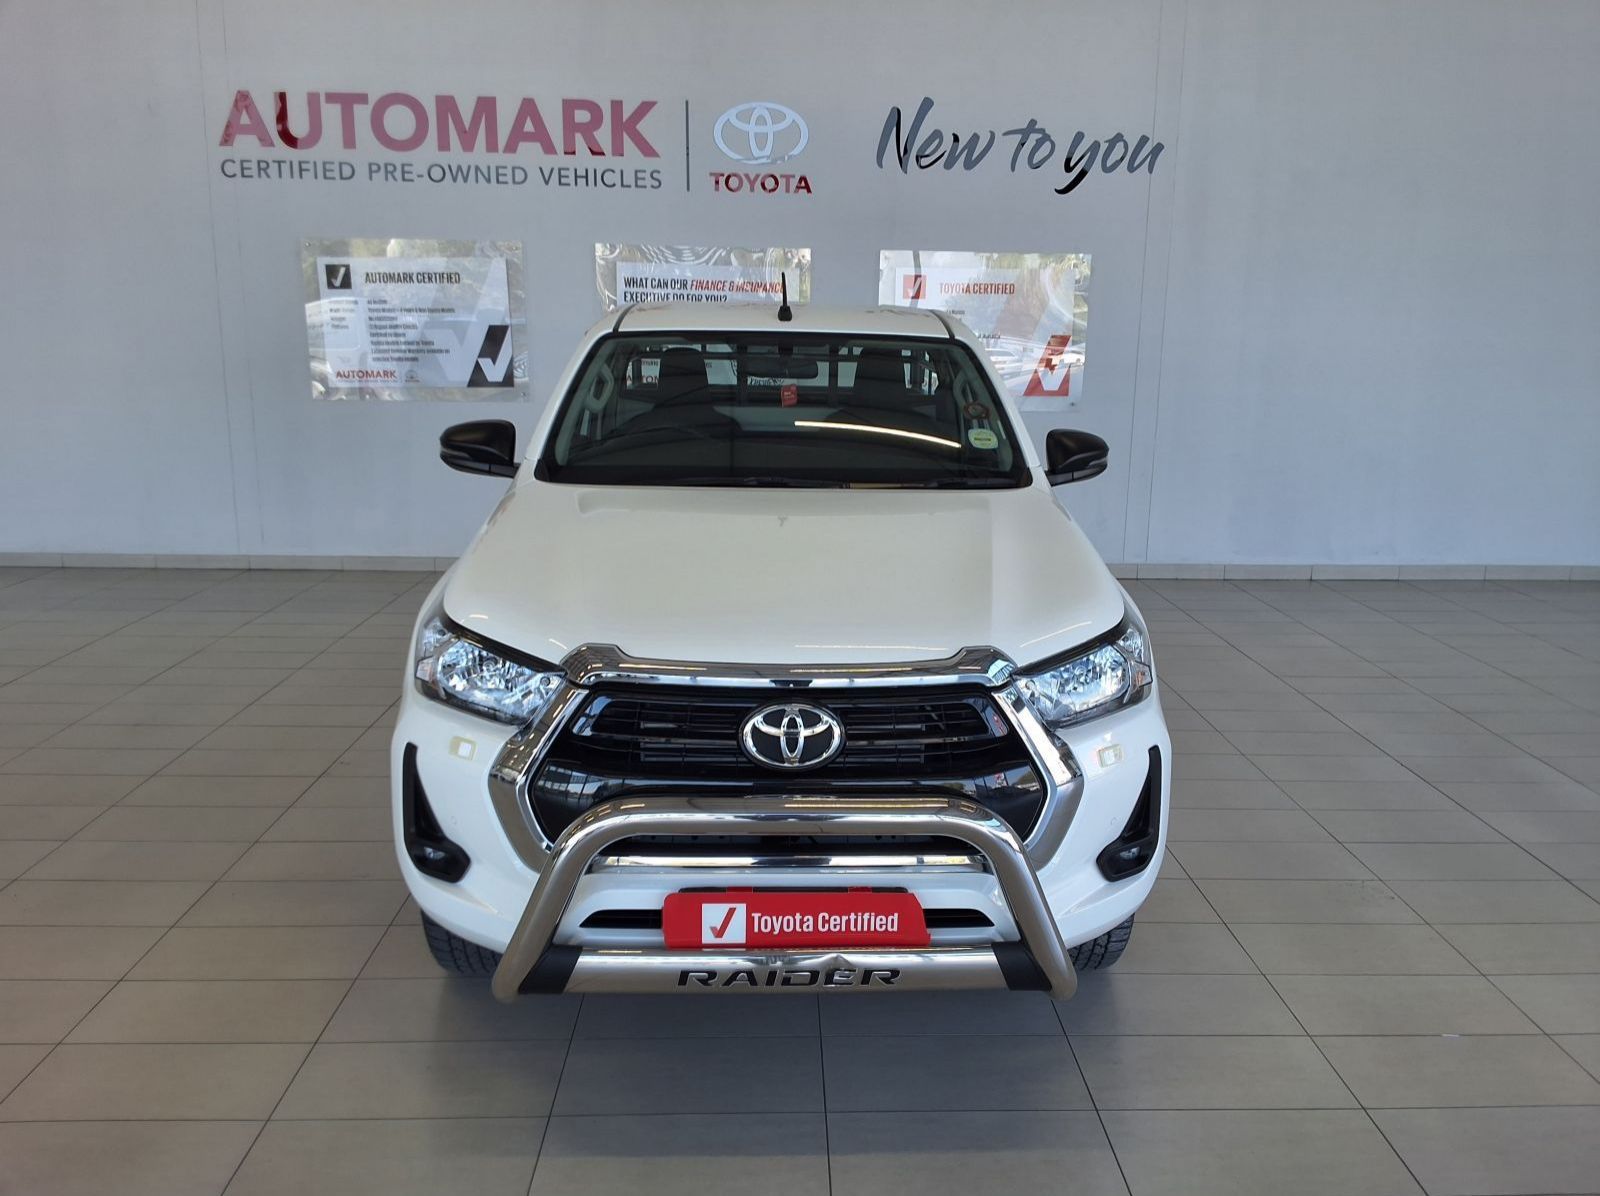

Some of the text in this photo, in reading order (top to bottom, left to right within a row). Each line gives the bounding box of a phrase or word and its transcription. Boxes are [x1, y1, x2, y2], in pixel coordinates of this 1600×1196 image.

[219, 90, 660, 158] AUTOMARK
[876, 97, 1165, 195] New to you
[221, 159, 662, 189] CERTIFIED PRE-OWNED VEHICLES
[710, 172, 812, 194] TOYOTA
[365, 272, 461, 285] AUTOMARK CERTIFIED
[623, 277, 649, 289] WHAT
[651, 278, 669, 290] CAN
[670, 278, 688, 290] OUR
[690, 279, 727, 292] FINANCE
[939, 282, 1015, 295] TOYOTA CERTIFIED
[623, 292, 671, 302] EXECUTIVE
[336, 369, 397, 380] AUTOMARK
[752, 912, 899, 935] Toyota Certified
[677, 968, 902, 988] RAIDER
